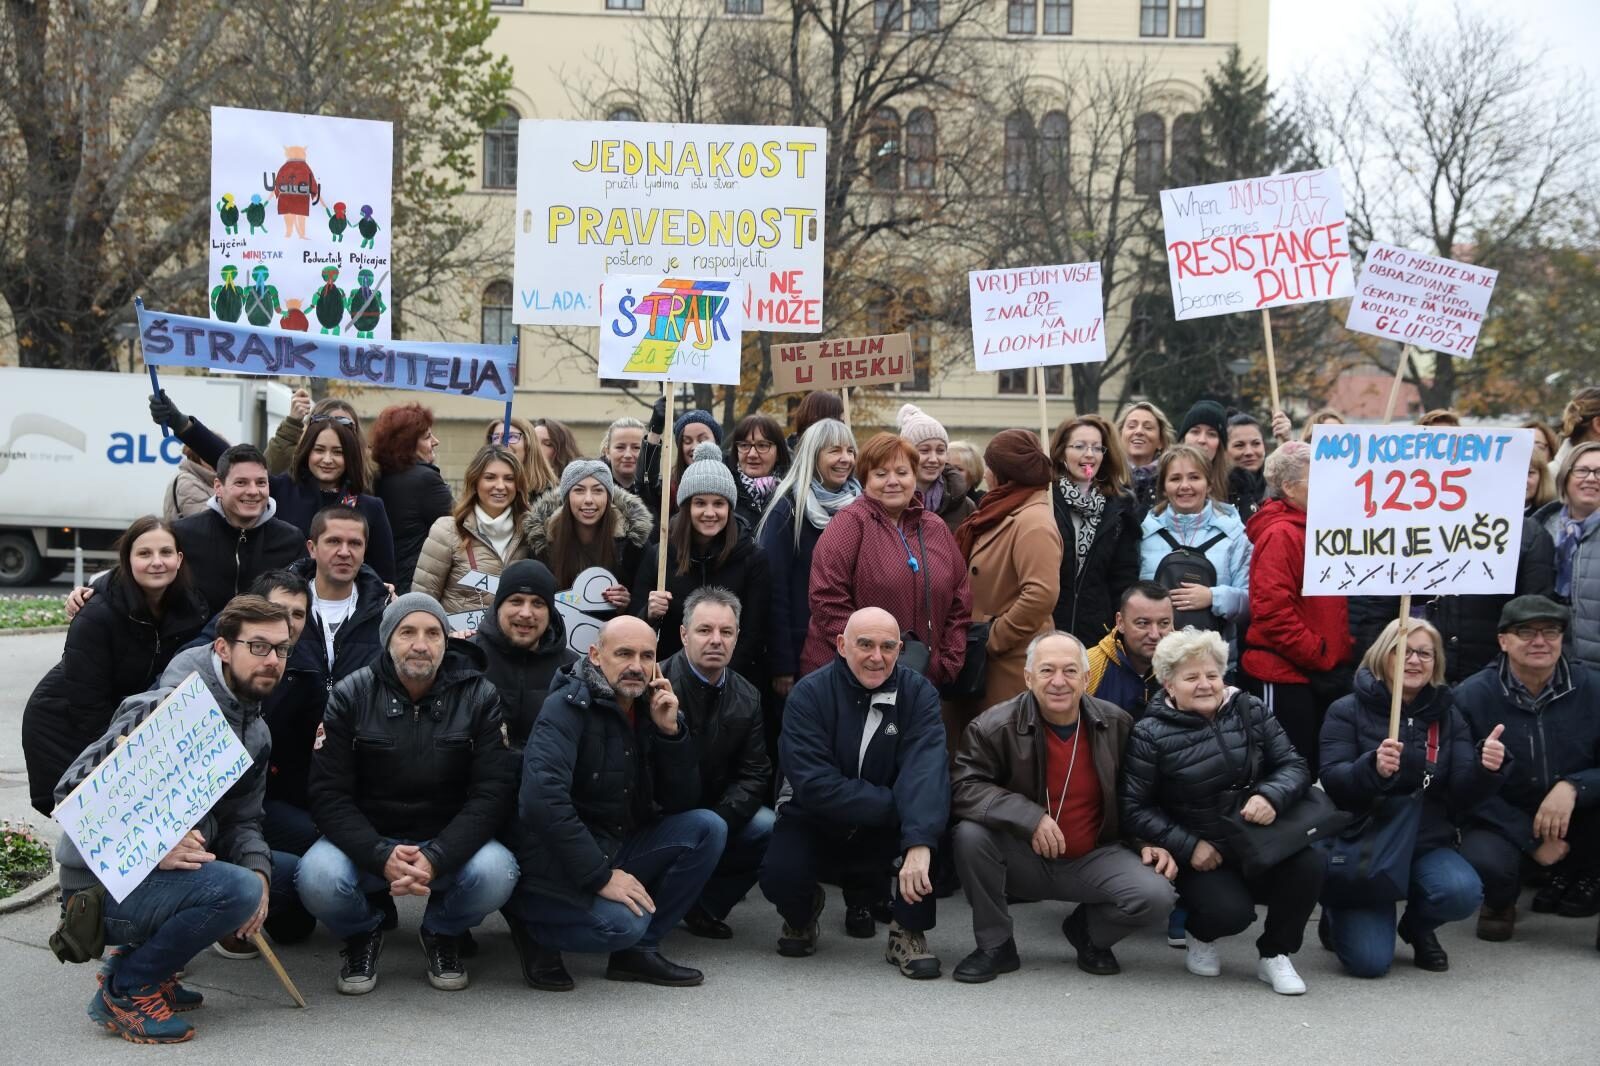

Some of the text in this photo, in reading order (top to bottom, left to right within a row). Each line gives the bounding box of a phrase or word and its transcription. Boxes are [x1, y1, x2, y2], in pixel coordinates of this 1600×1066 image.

[572, 140, 817, 178] JEDNAKOST
[606, 175, 638, 199] pružiti
[645, 174, 679, 197] ljudima
[1170, 171, 1329, 218] When INJUSTICE
[548, 205, 817, 249] PRAVEDNOST
[1200, 199, 1329, 240] becomes LAW
[242, 250, 283, 260] MINISTAR
[605, 248, 653, 274] pošteno
[662, 252, 679, 274] je
[1168, 221, 1349, 279] RESISTANCE
[1373, 248, 1495, 289] AKO MISLITE DA JE
[770, 270, 804, 294] NE
[976, 269, 1059, 295] VRIJEDIM
[1026, 291, 1050, 304] OD
[1178, 261, 1339, 317] becomes DUTY
[612, 288, 731, 351] ŠTRAJK
[757, 296, 821, 326] MOŽE
[1041, 316, 1065, 328] NA
[1360, 300, 1463, 333] KOLIKO KOŠTA
[1421, 300, 1436, 313] DA
[1442, 306, 1483, 323] VIDITE
[144, 318, 319, 371] ŠTRAJK
[781, 337, 884, 362] NE ŽELIM
[795, 365, 813, 383] U
[1315, 432, 1513, 468] MOJ KOEFICIJENT
[1354, 467, 1472, 518] 1,235
[1315, 512, 1510, 557] KOLIKI JE VAŠ?
[79, 708, 220, 848] KAKO SU VAM DJECA
[108, 719, 184, 799] GOVORITI
[90, 835, 114, 860] NA
[120, 764, 181, 827] PRVOM
[100, 860, 110, 873] A
[201, 734, 232, 767] ONE
[117, 839, 148, 878] KOJI
[155, 811, 176, 837] IH
[145, 841, 168, 868] NA
